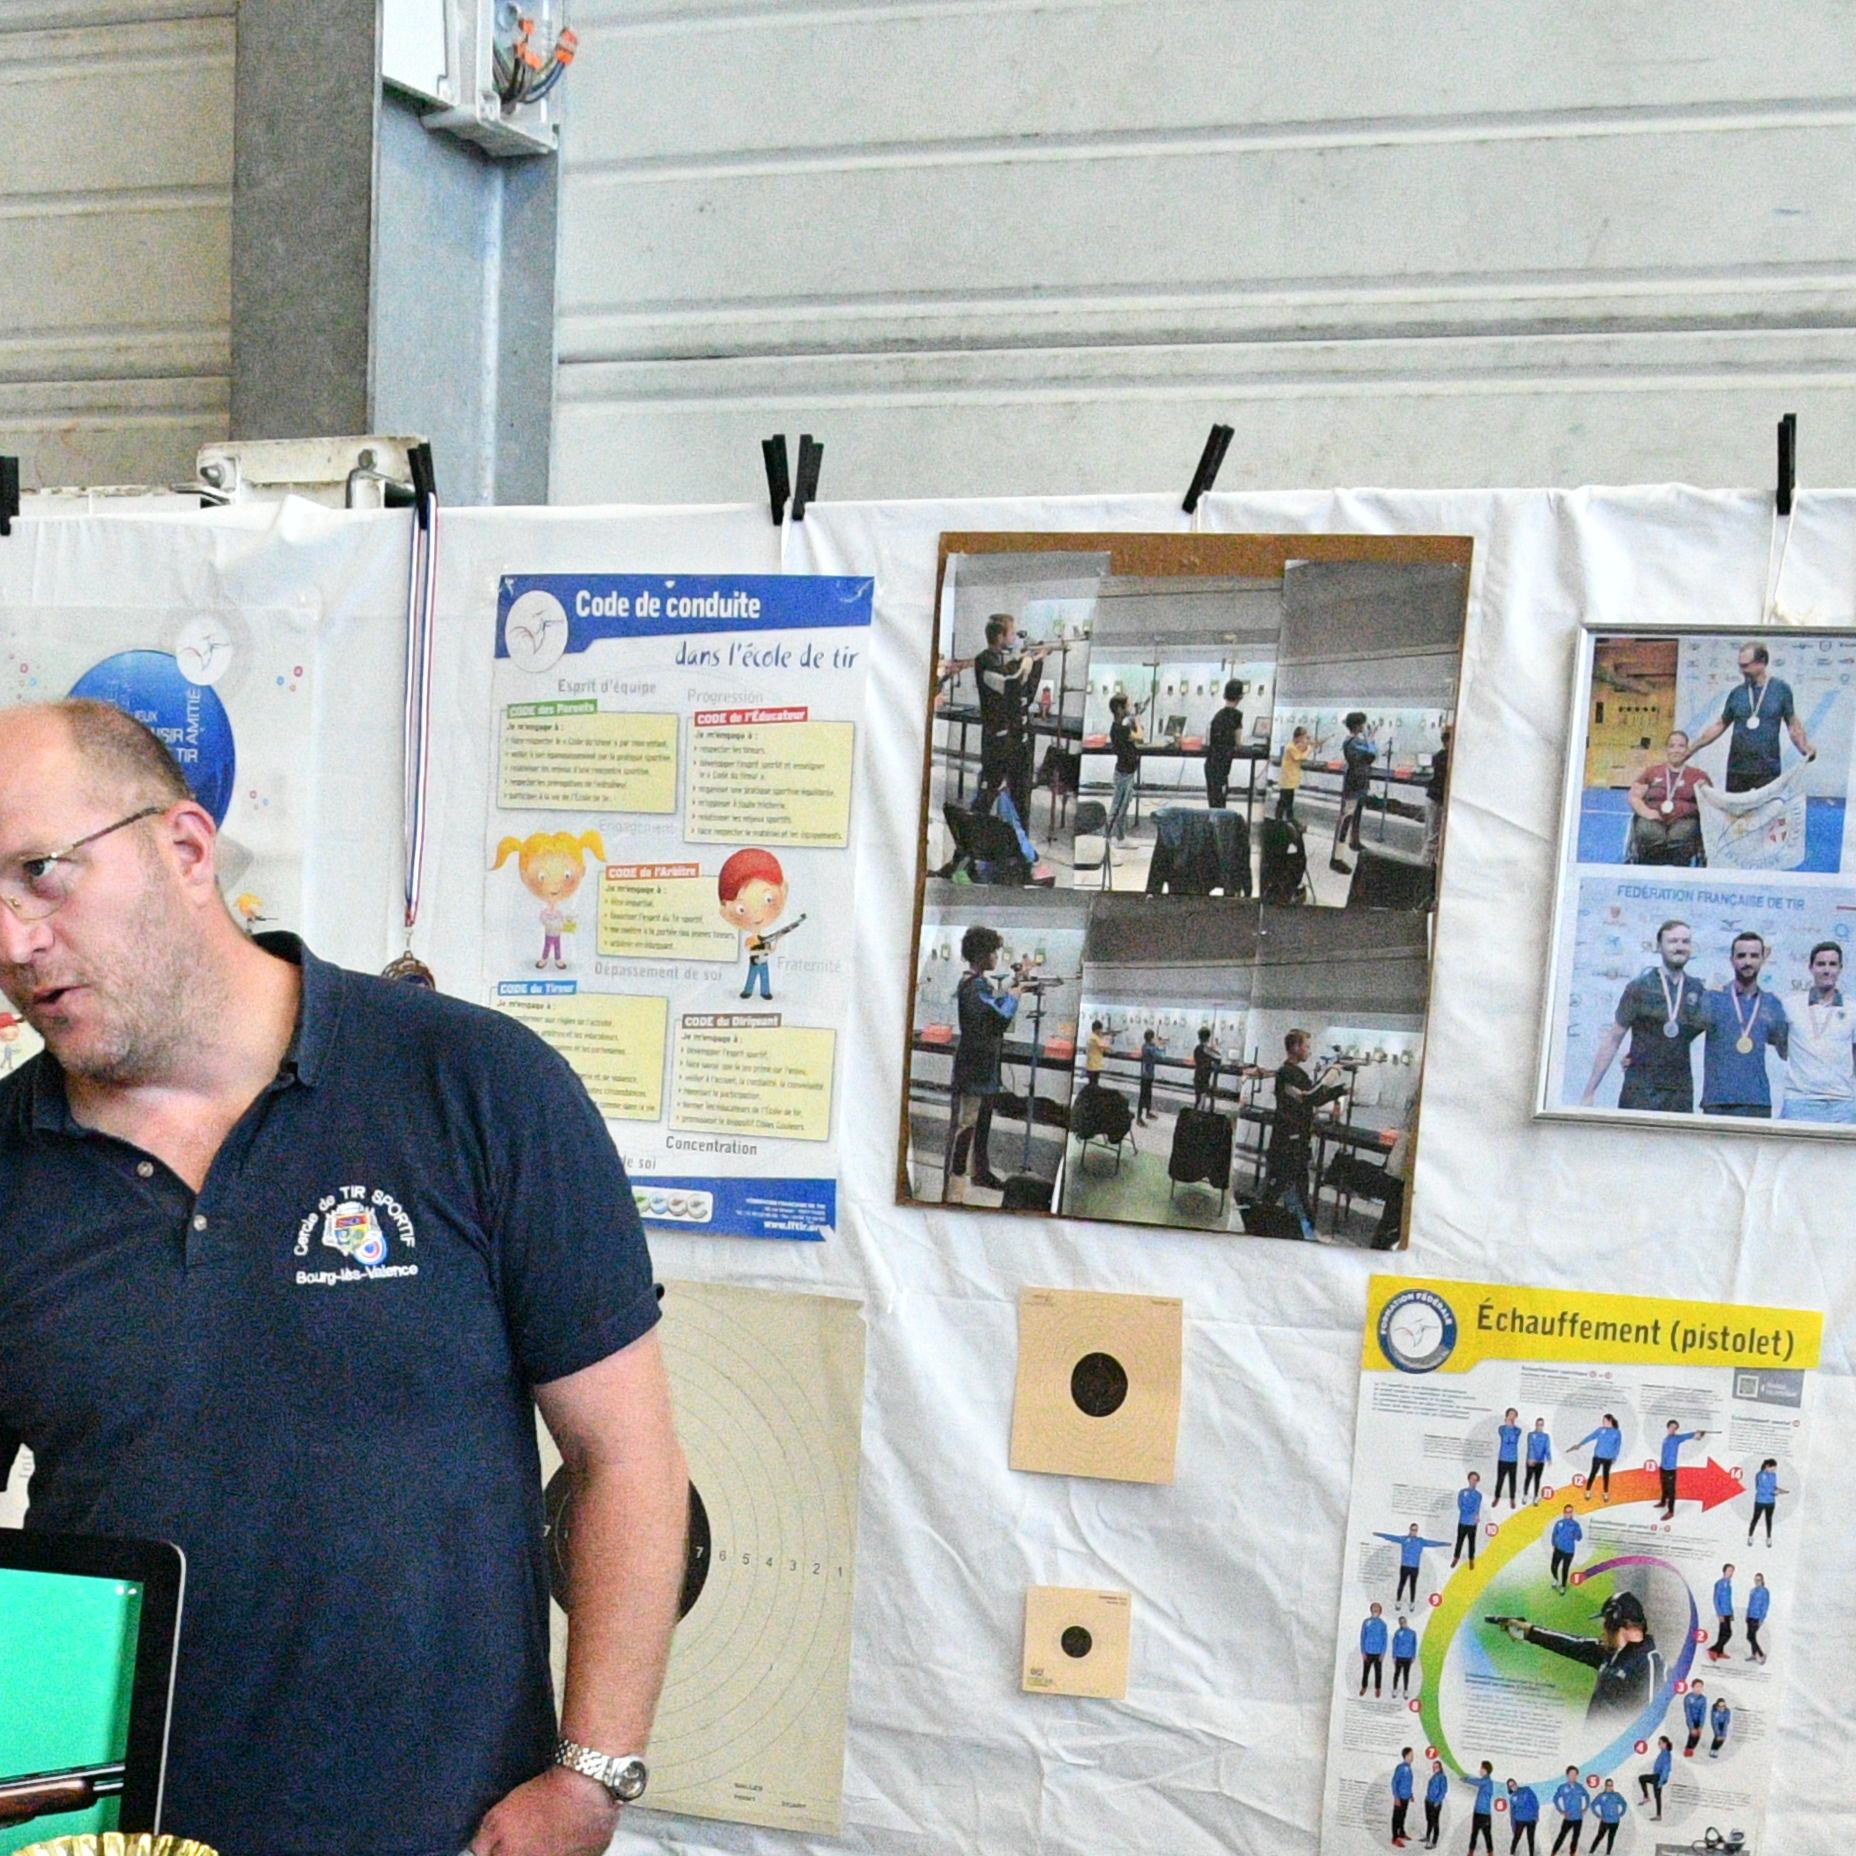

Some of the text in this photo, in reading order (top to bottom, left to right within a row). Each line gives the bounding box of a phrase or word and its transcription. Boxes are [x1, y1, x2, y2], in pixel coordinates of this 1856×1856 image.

[576, 590, 761, 619] Code de conduite
[675, 641, 859, 669] dans l'école de tir
[558, 679, 657, 697] Esprit d'équipe
[687, 689, 763, 706] Progression
[186, 688, 201, 745] AMITIÉ
[509, 705, 536, 717] CODE
[697, 713, 727, 724] CODE
[745, 709, 806, 722] l'Éducateur
[609, 867, 637, 879] CODE
[1767, 896, 1782, 909] DE
[1785, 898, 1805, 911] TIR
[595, 962, 723, 981] Dépassement de soi
[778, 957, 841, 973] Fraternité
[500, 983, 527, 994] CODE
[685, 1015, 778, 1028] CODE du Dirigeant
[666, 1136, 757, 1155] Concentration
[639, 1156, 656, 1169] soi
[294, 1185, 416, 1256] Cercle de TIR SPORTIF
[1380, 1292, 1416, 1335] FORMATION
[1477, 1298, 1795, 1361] Échauffement (pistolet)
[695, 1546, 704, 1558] 7
[719, 1550, 727, 1562] 6
[742, 1553, 750, 1565] 5
[765, 1557, 773, 1567] 4
[789, 1560, 797, 1572] 3
[813, 1563, 821, 1575] 2
